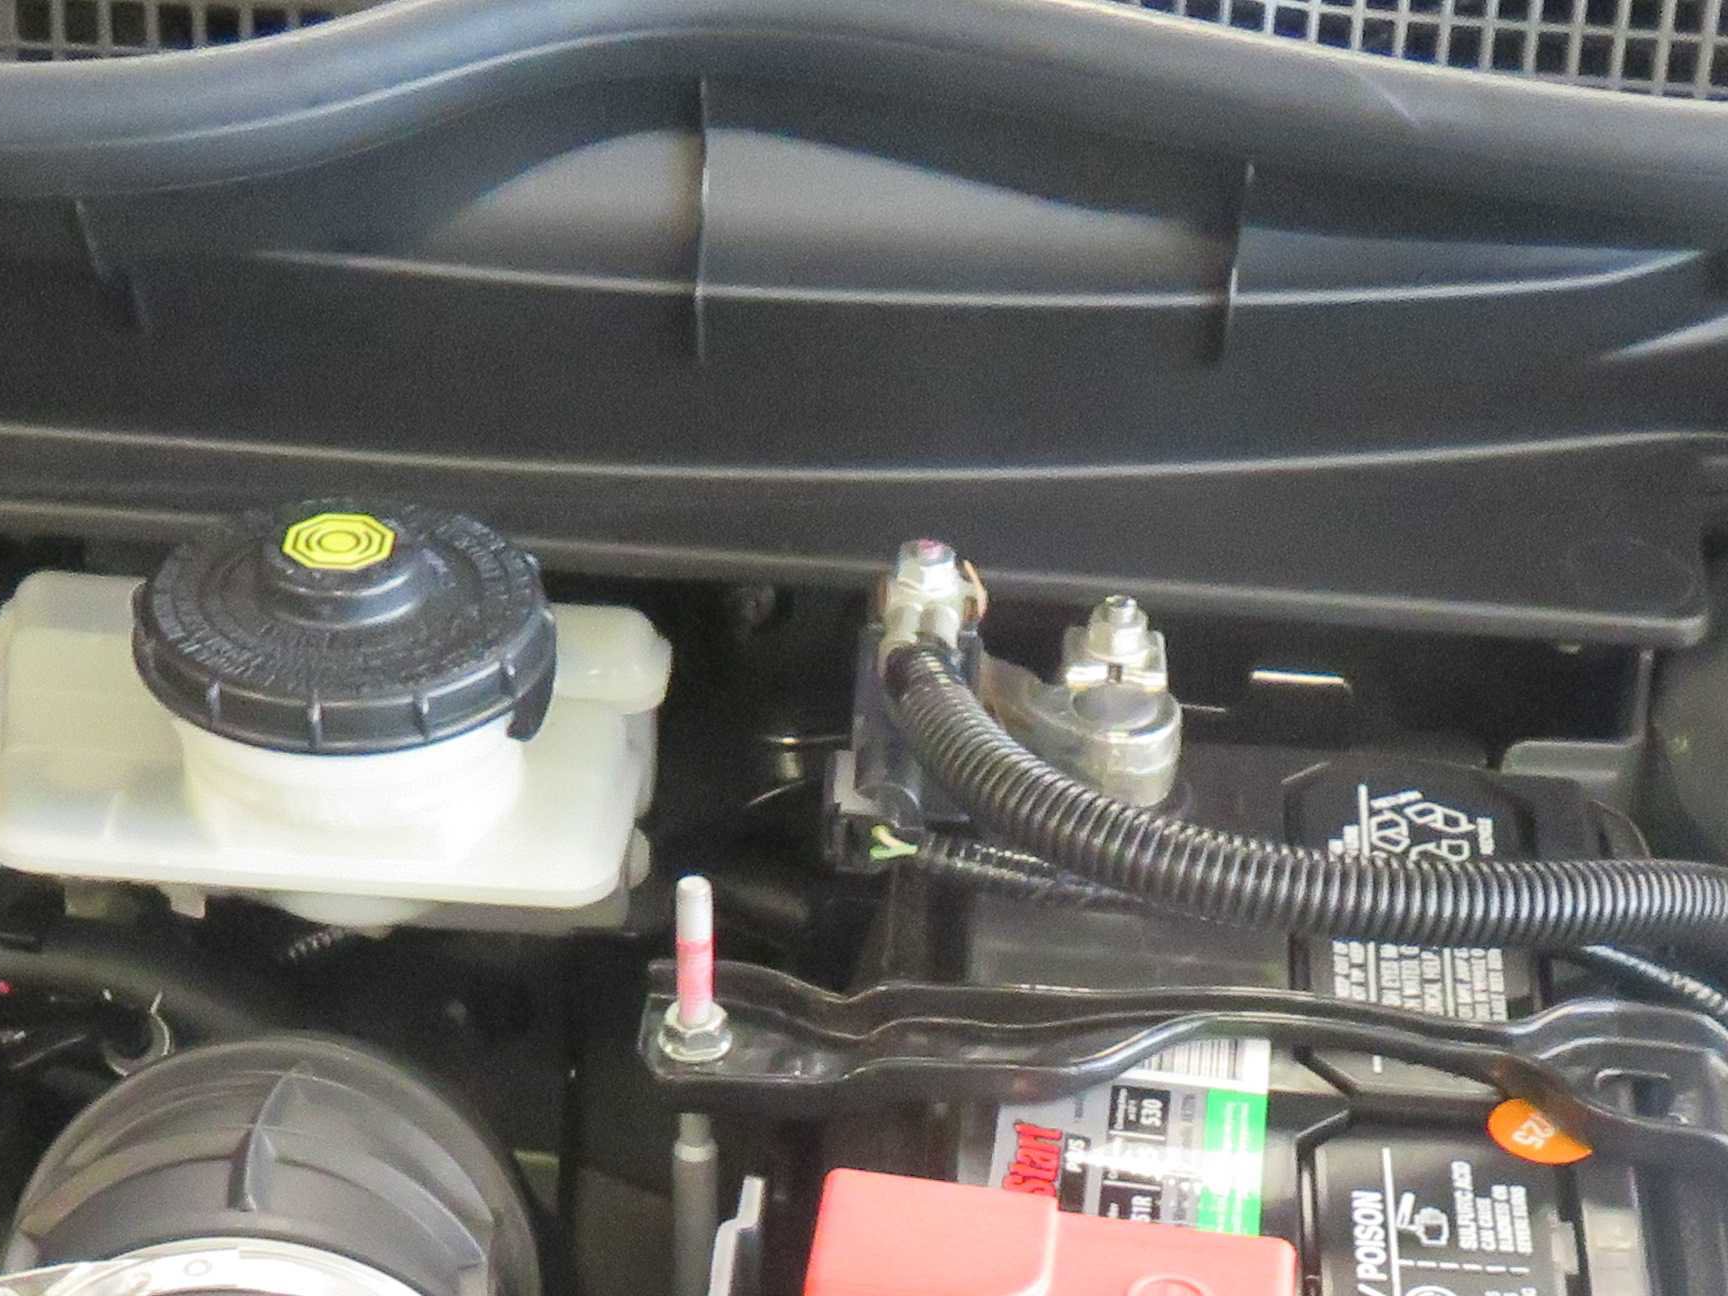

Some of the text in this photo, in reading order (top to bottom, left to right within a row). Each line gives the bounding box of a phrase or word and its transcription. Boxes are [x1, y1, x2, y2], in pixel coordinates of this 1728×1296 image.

[1140, 1098, 1164, 1128] 530
[1351, 1190, 1388, 1281] POISON
[1451, 1160, 1478, 1251] SULFURIC ACID
